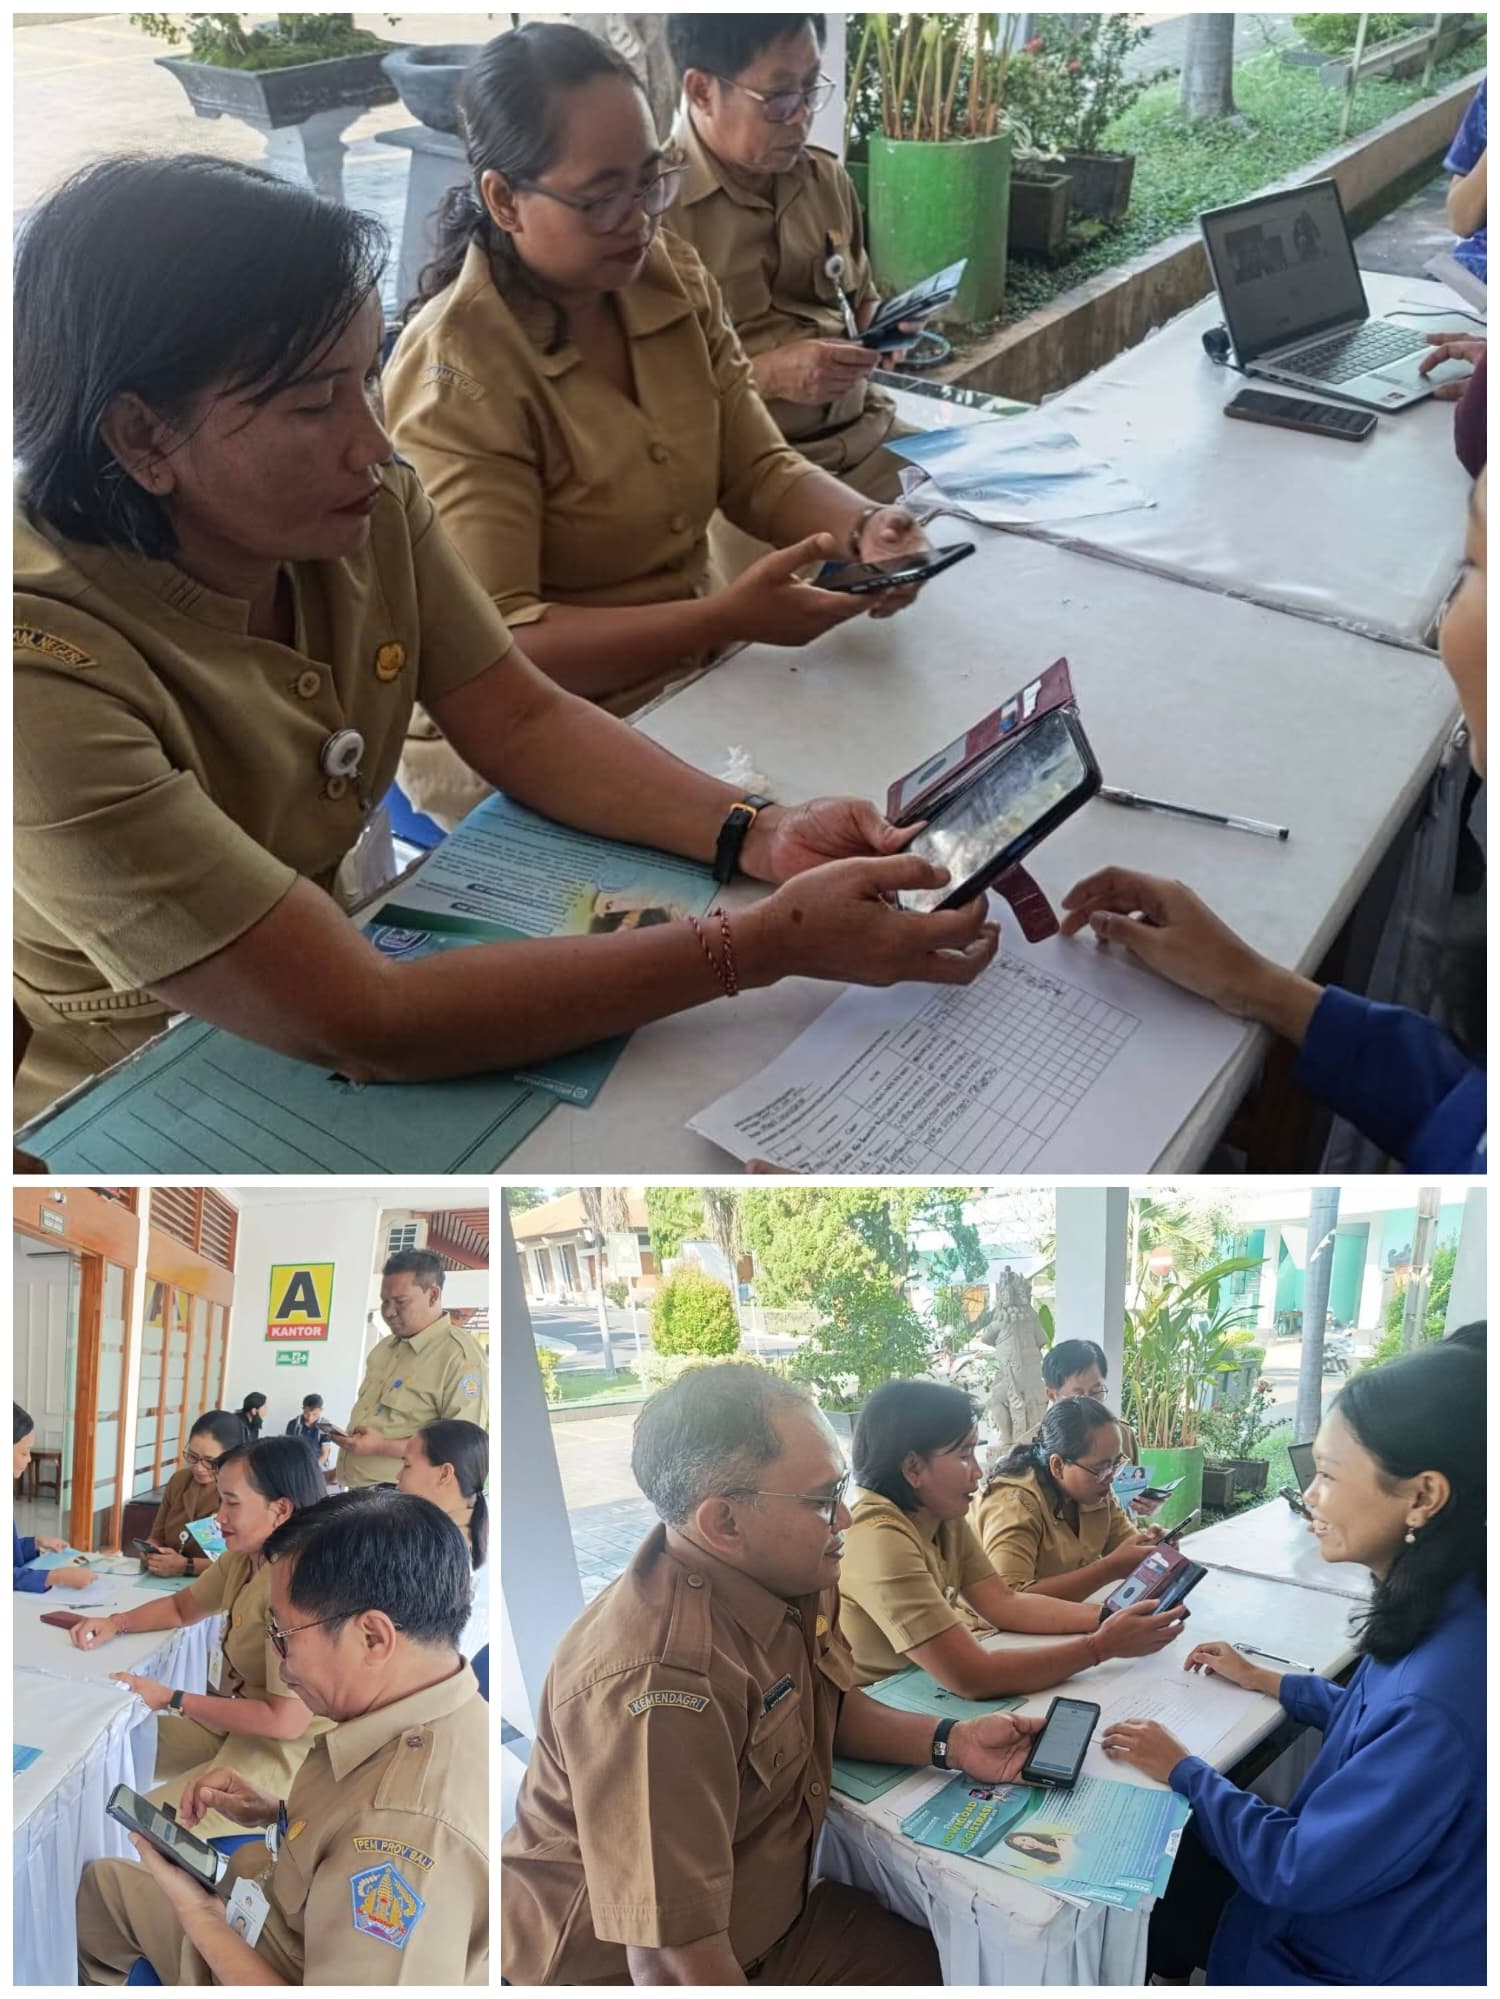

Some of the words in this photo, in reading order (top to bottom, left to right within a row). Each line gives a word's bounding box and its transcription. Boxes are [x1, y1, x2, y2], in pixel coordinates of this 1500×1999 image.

[275, 1270, 322, 1319] A
[271, 1326, 322, 1337] KANTOR
[632, 1692, 704, 1712] KEMENDAGRI
[381, 1841, 410, 1857] PROV
